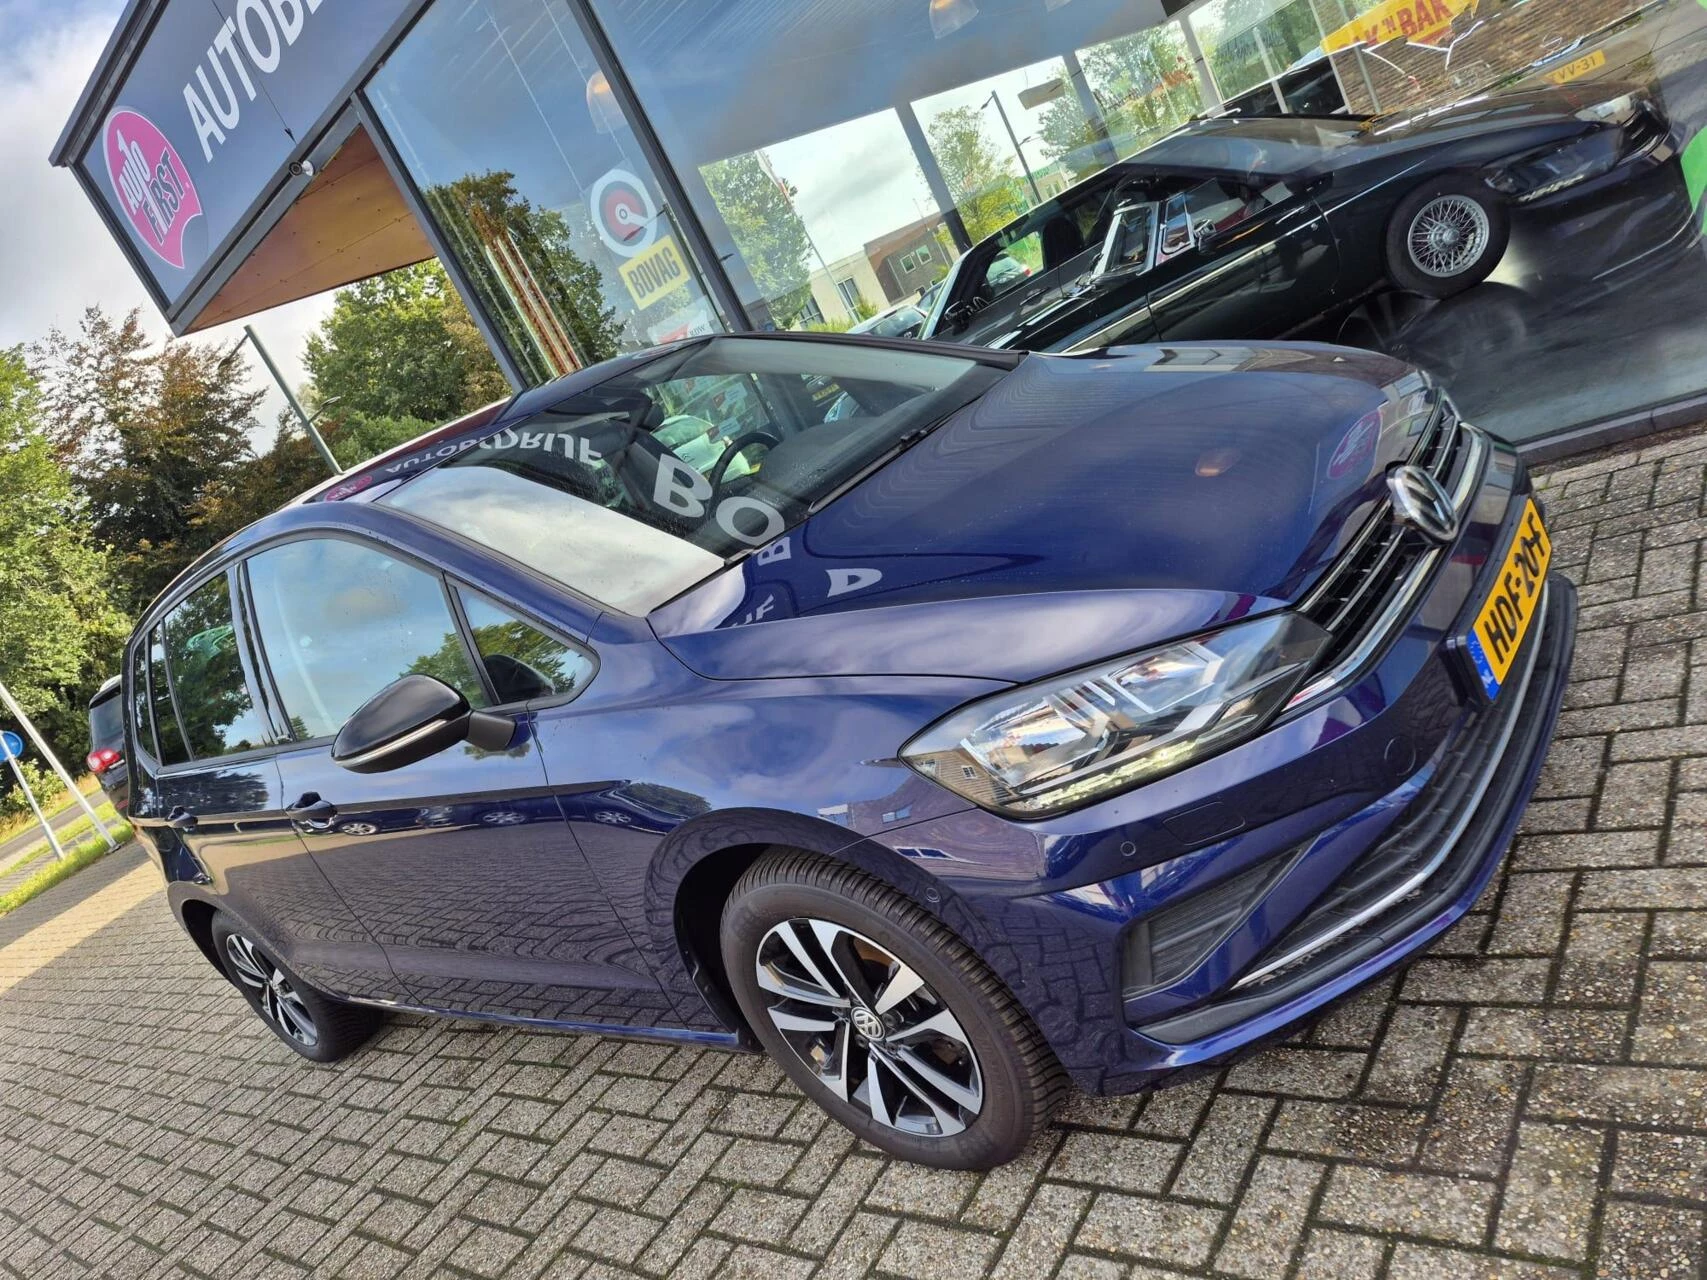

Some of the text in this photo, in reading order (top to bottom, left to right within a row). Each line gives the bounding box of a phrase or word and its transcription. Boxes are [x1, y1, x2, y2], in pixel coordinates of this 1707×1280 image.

[183, 0, 323, 163] AUTOB
[117, 128, 151, 216] AUTO
[141, 147, 184, 246] FIRST
[627, 246, 681, 299] BOVAG
[1484, 512, 1546, 665] HDF-20-F
